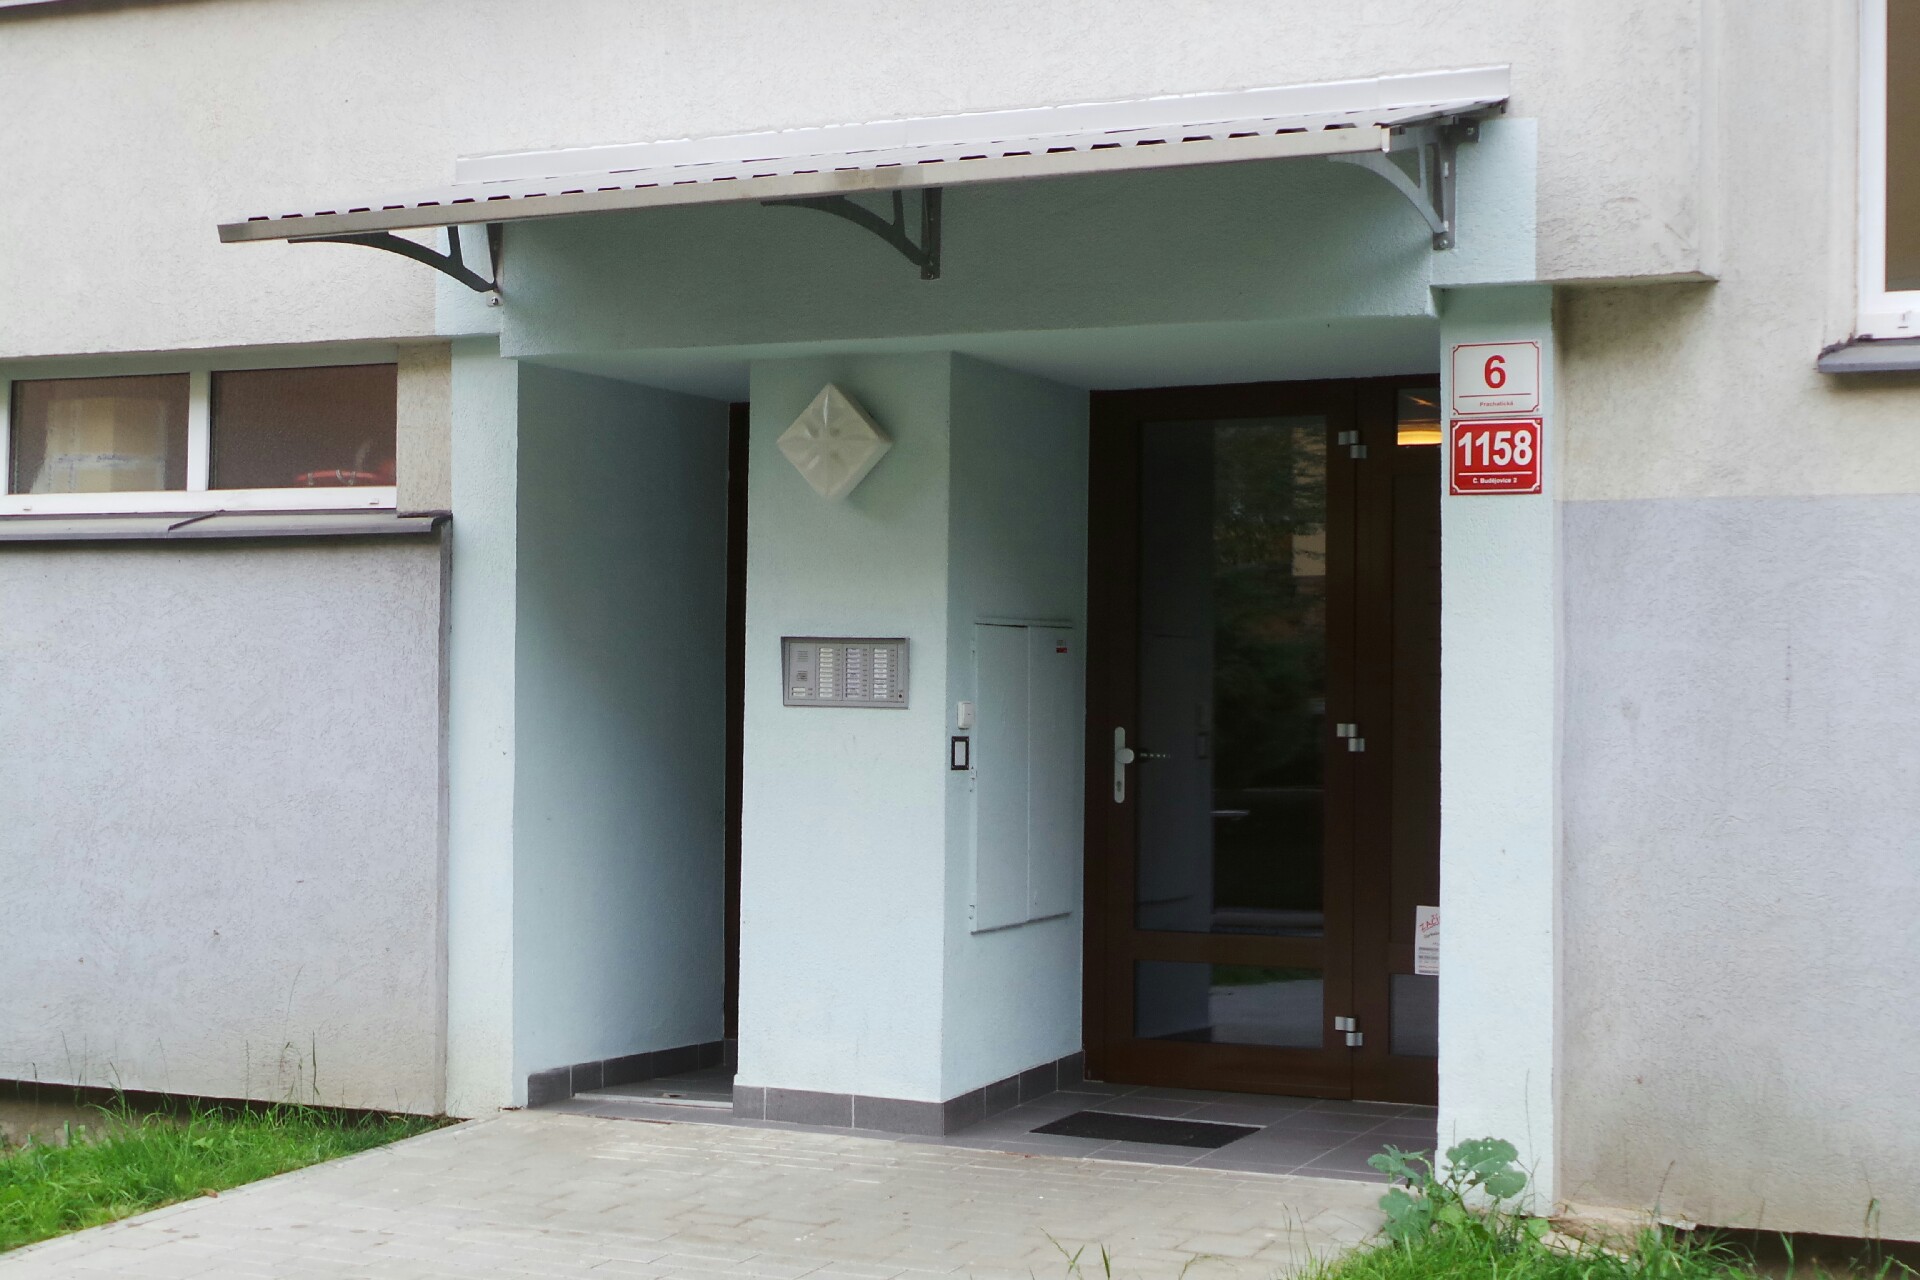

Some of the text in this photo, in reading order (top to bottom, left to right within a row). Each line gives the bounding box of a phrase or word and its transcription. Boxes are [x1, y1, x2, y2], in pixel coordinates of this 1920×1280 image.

[1484, 355, 1506, 389] 6
[1458, 430, 1533, 466] 1158
[1480, 477, 1512, 485] Budějovice
